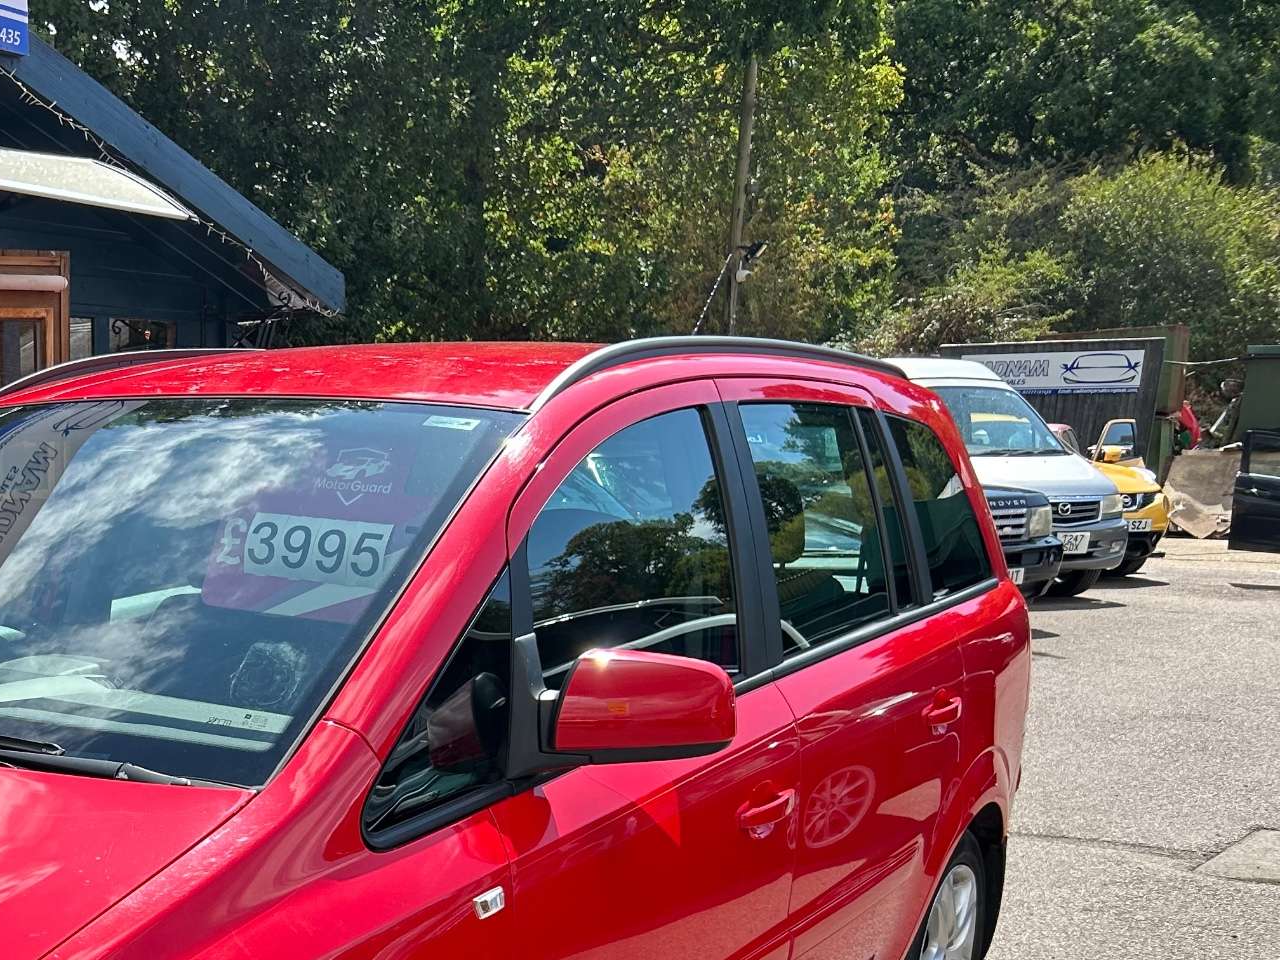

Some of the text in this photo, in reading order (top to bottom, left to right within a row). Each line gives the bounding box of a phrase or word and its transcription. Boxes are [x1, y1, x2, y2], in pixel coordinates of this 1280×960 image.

[313, 478, 392, 494] MotorGuard
[989, 499, 1026, 507] ROVER
[1131, 520, 1148, 530] SZJ
[216, 517, 385, 578] £3995
